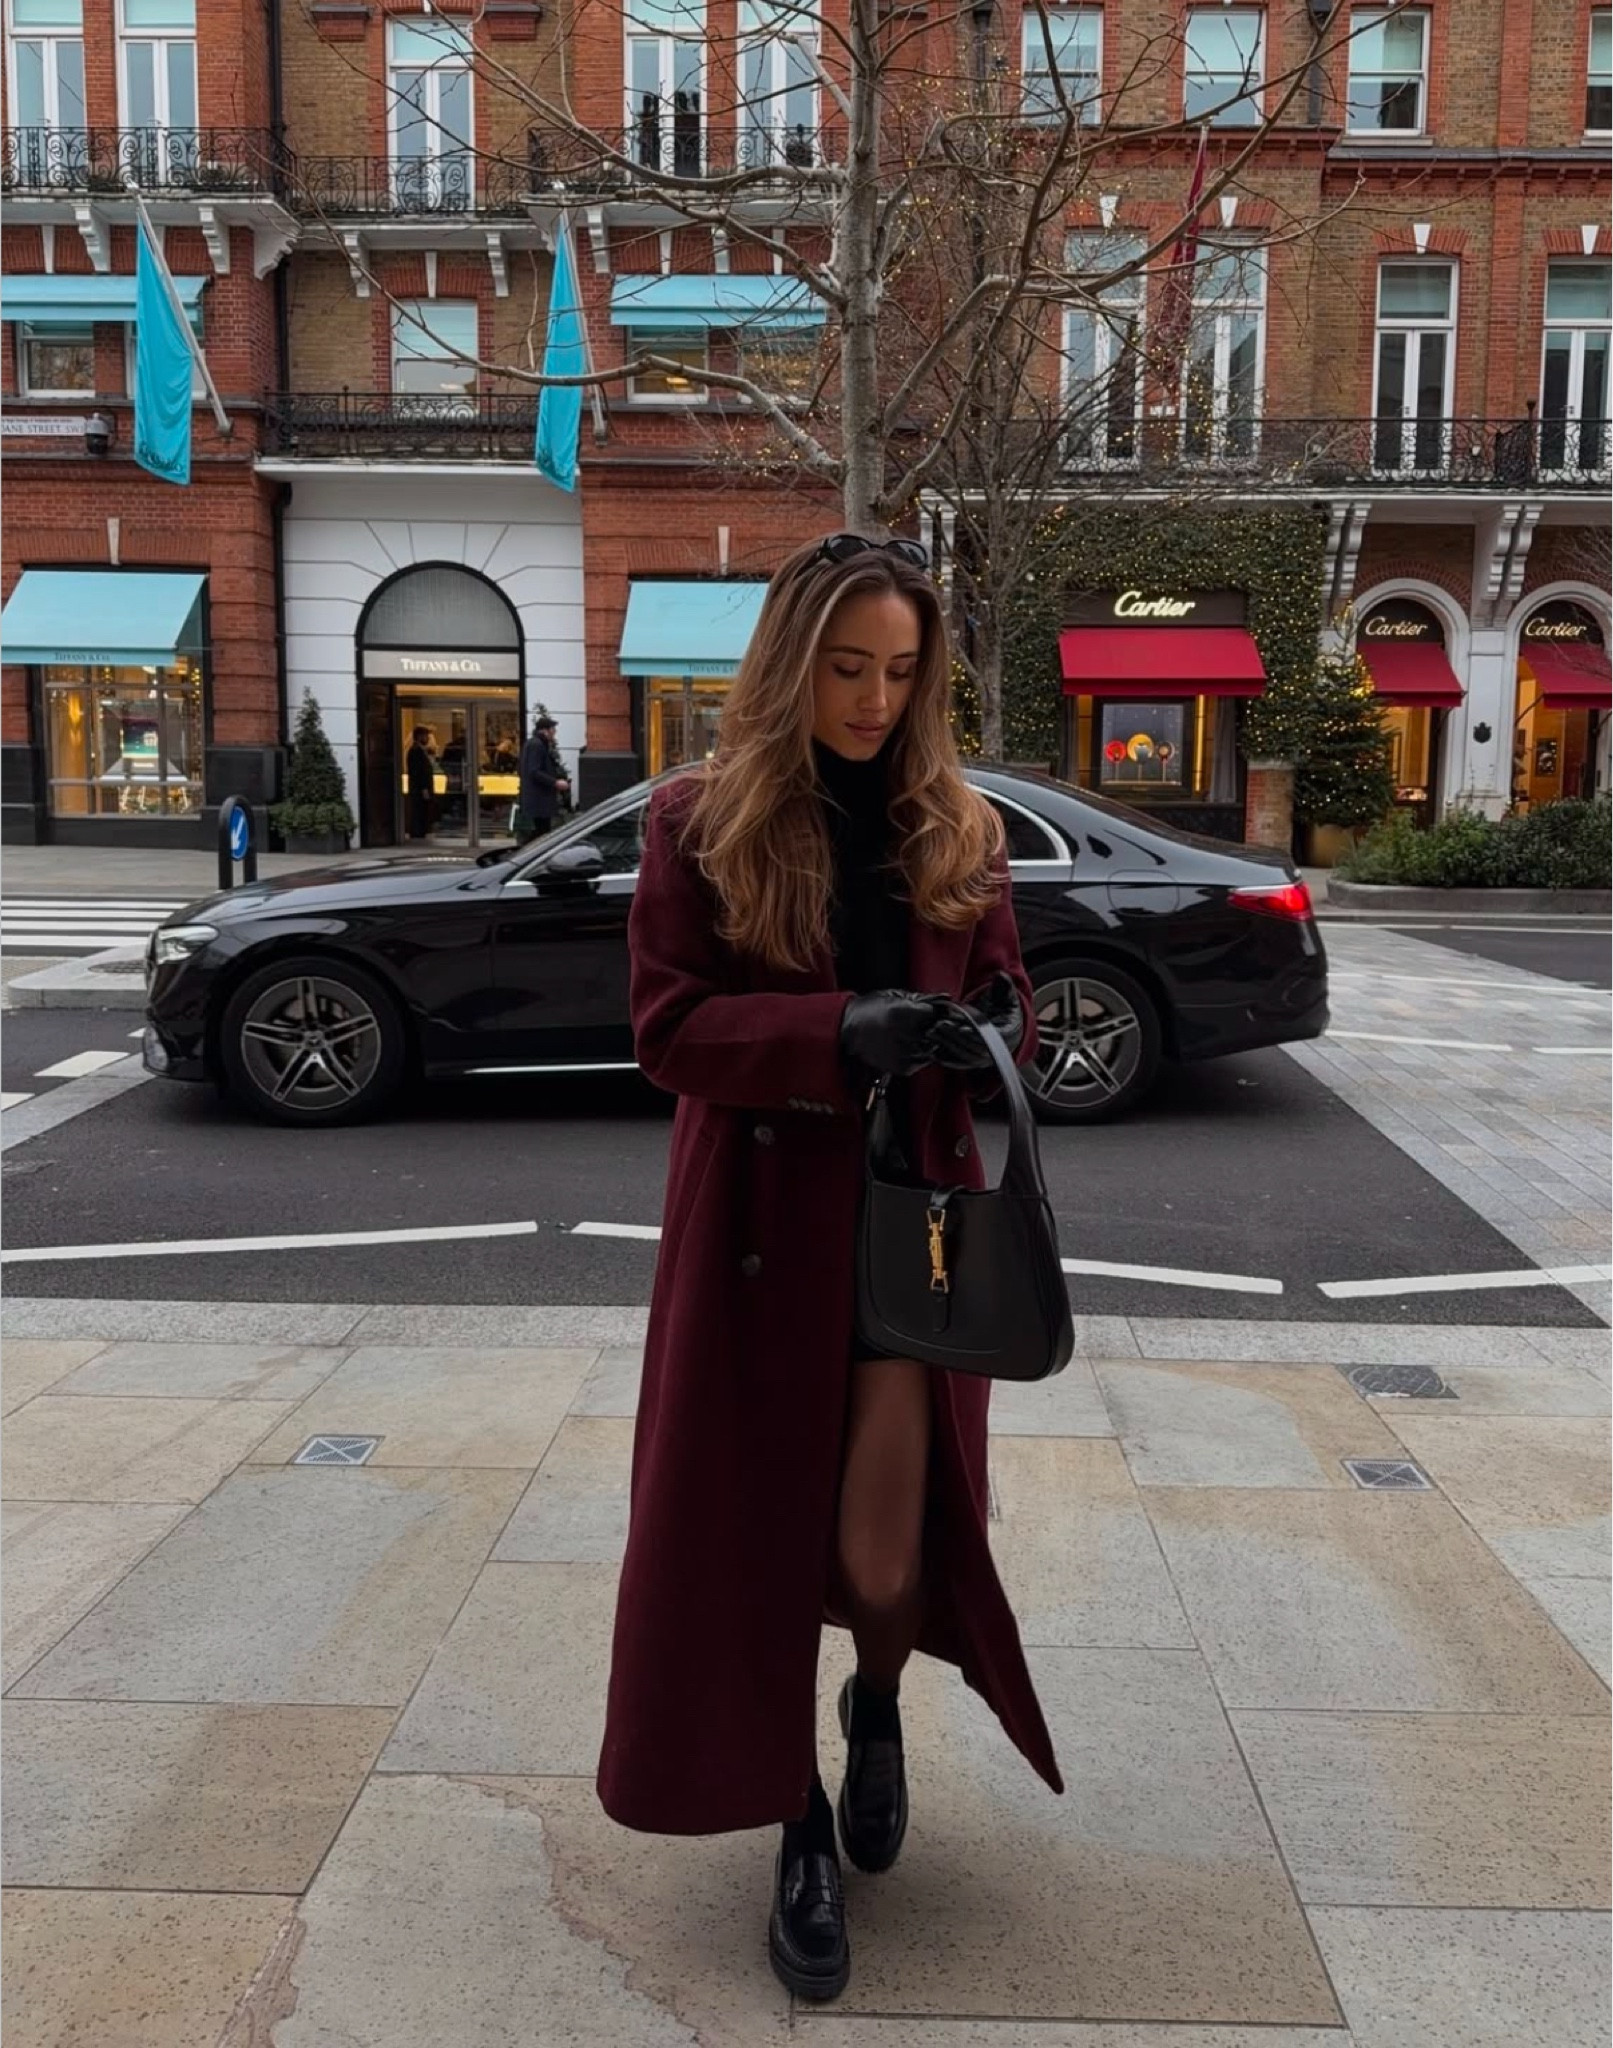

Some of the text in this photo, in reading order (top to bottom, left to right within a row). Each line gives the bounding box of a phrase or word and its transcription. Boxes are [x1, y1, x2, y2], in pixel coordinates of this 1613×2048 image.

[27, 423, 61, 434] STREET
[1114, 590, 1196, 617] Cartier
[1365, 615, 1429, 636] Cartier
[1525, 617, 1588, 637] Cartier
